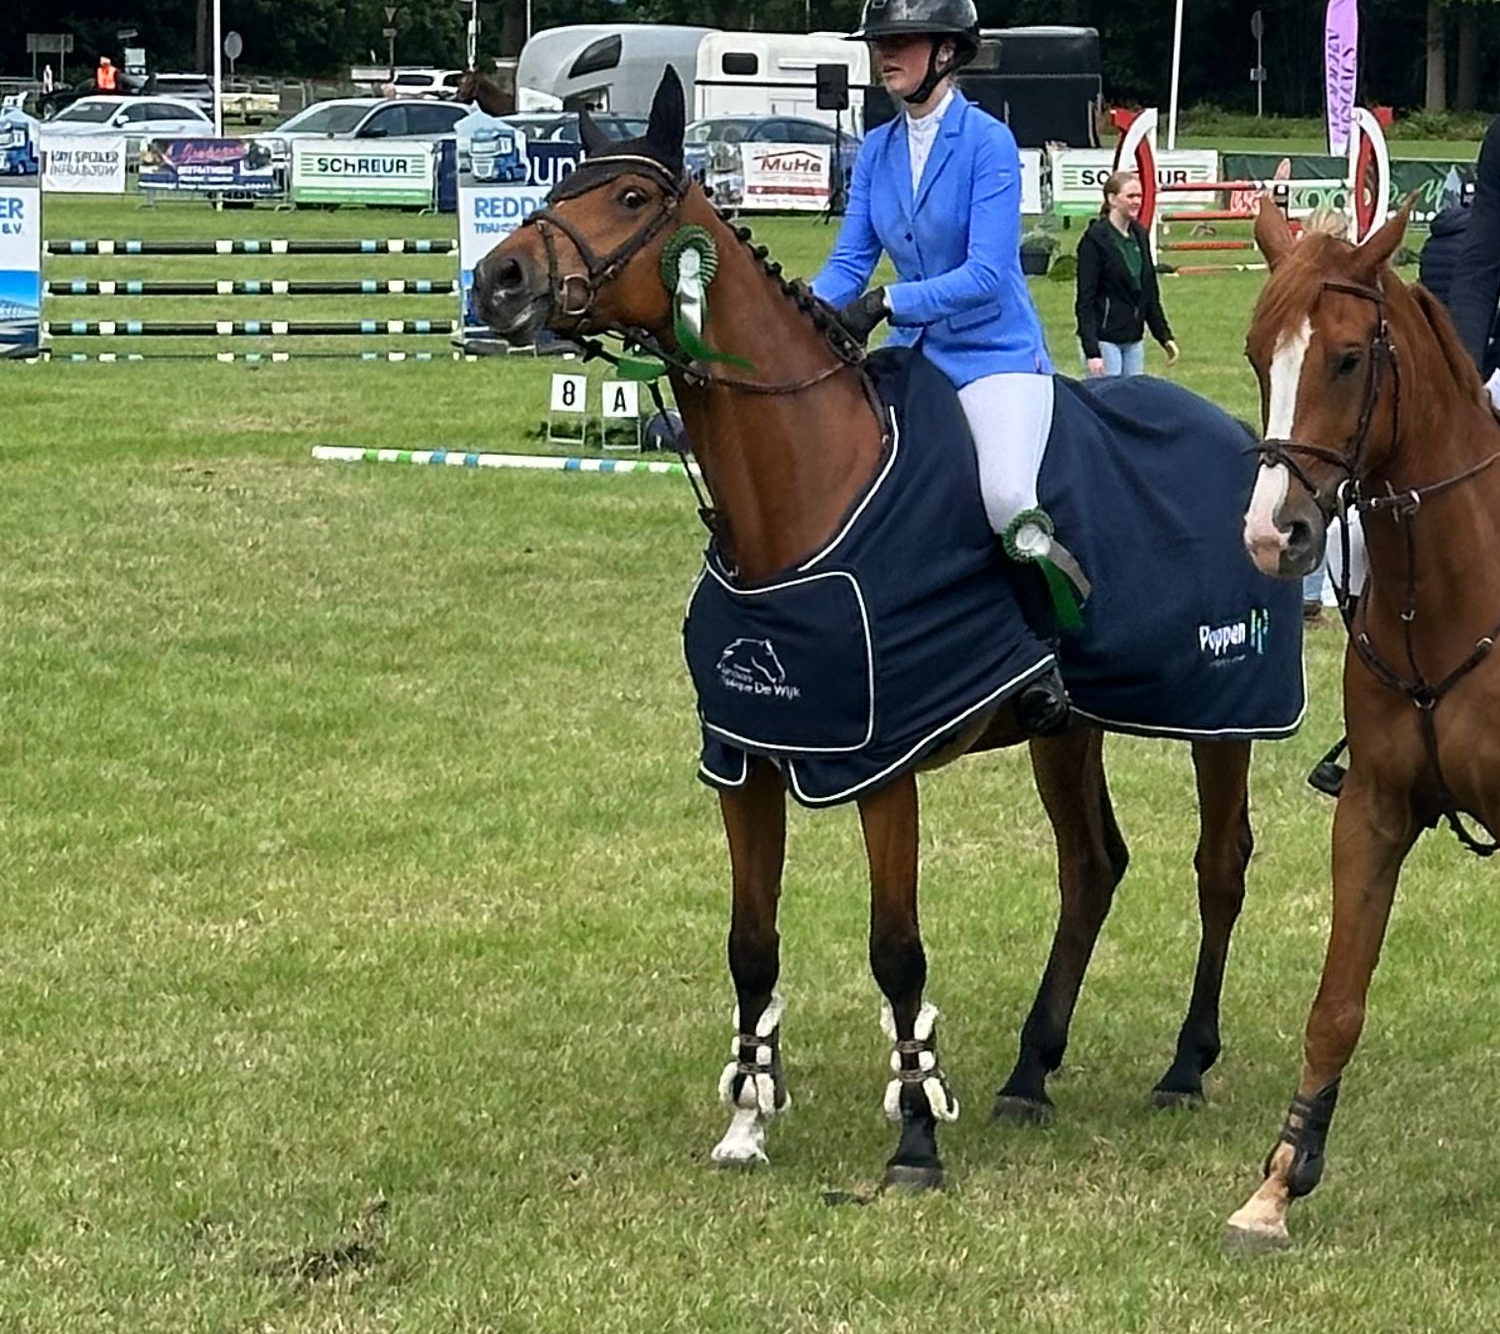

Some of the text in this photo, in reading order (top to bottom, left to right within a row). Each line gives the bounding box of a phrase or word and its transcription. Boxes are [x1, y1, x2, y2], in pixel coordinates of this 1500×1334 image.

[562, 380, 576, 406] 8
[612, 386, 627, 412] A
[1199, 622, 1246, 656] Poppen
